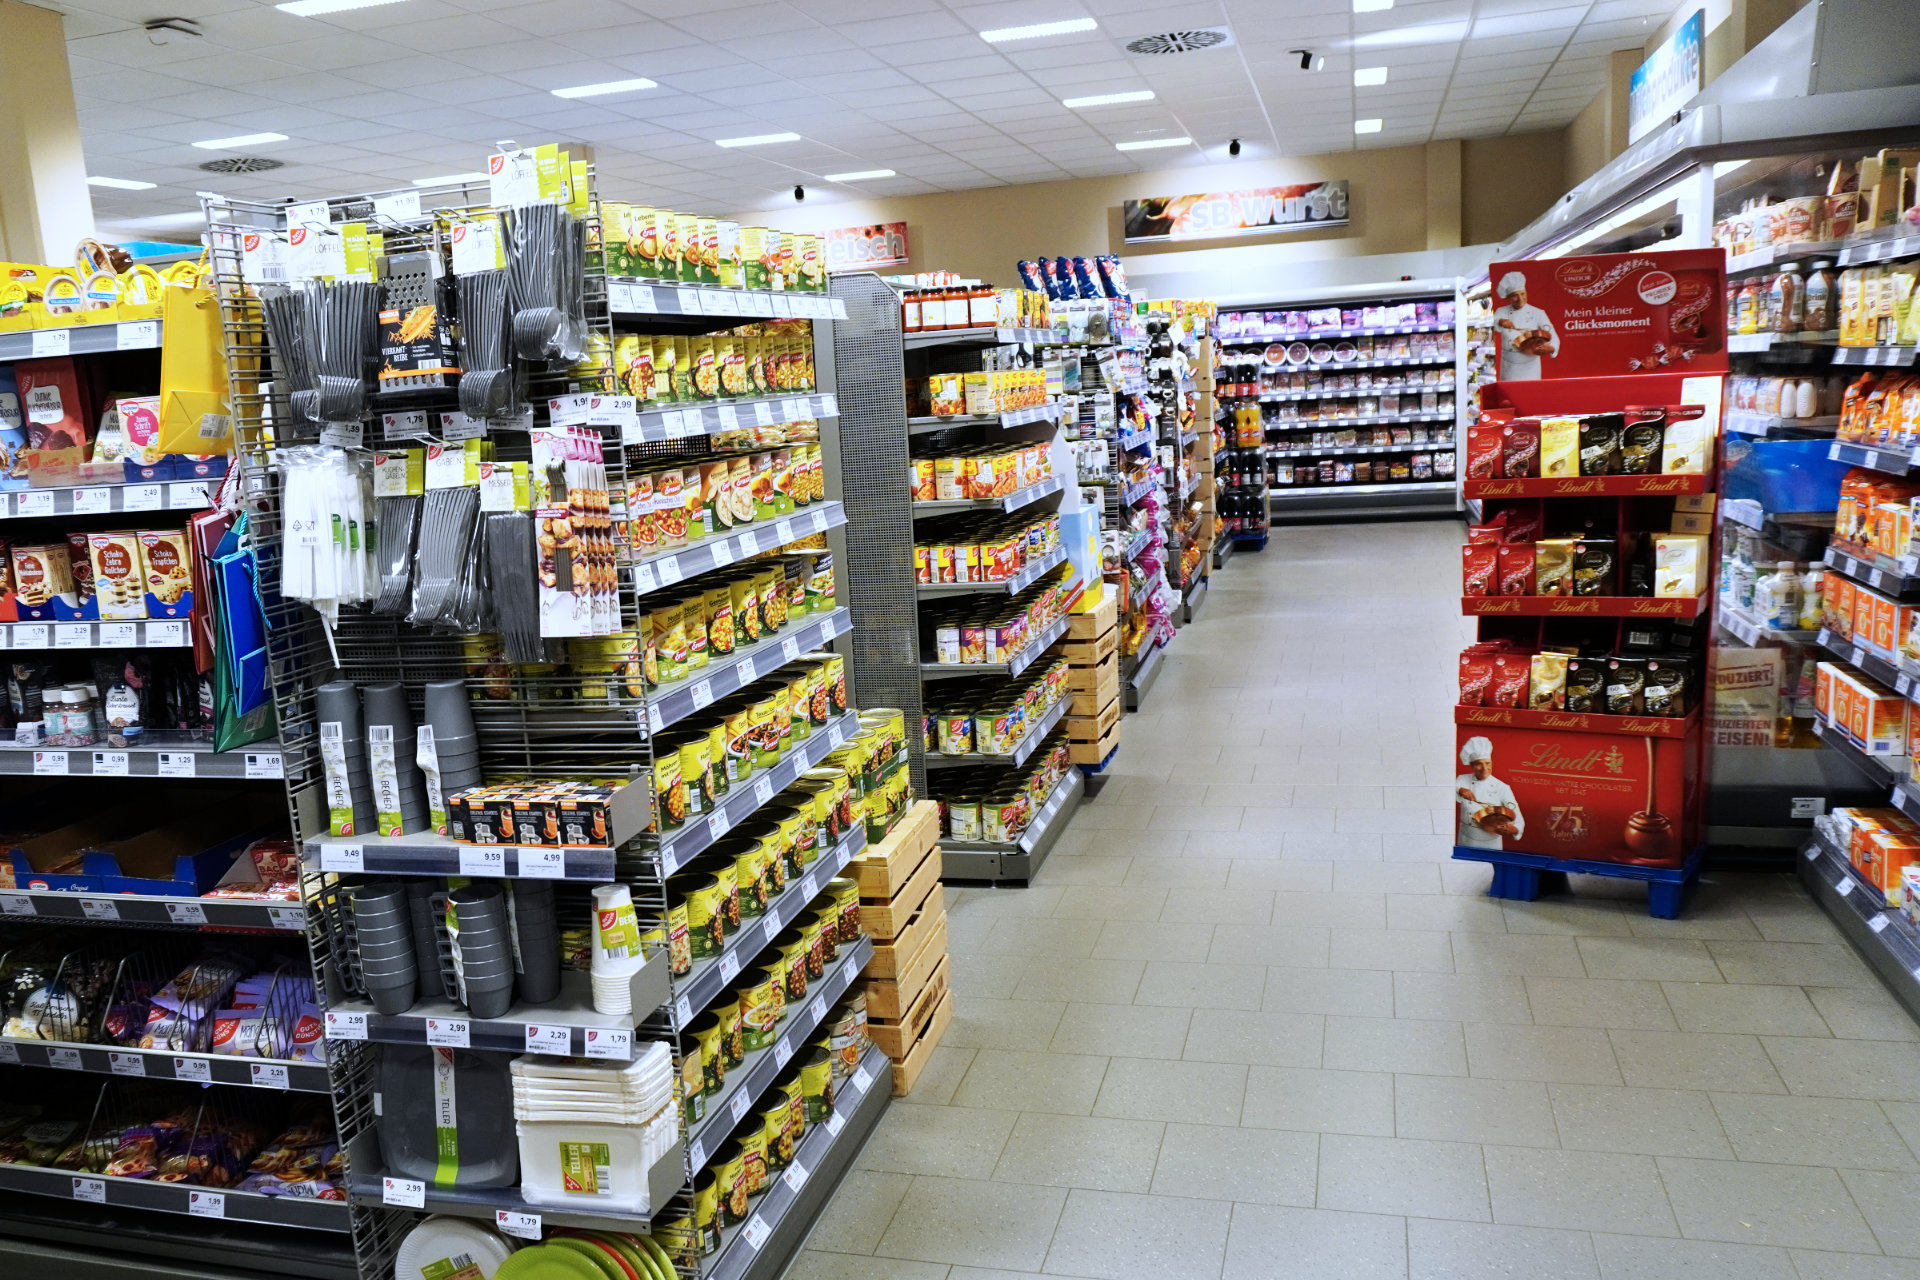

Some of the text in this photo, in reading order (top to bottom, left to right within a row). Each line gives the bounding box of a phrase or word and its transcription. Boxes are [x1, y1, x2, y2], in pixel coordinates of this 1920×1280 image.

[1190, 187, 1347, 229] SB Wurst
[830, 230, 904, 261] eisch
[1564, 305, 1634, 318] Mein kleiner
[1564, 317, 1651, 331] Glücksmoment
[614, 400, 632, 408] 2,99
[406, 415, 424, 424] 1,79
[344, 424, 360, 433] 1,39
[1478, 482, 1516, 496] Lindt
[1555, 480, 1595, 494] Lindt
[1637, 475, 1680, 491] Lindt
[1474, 599, 1514, 613] Lindt
[1550, 600, 1589, 613] Lindt
[1632, 600, 1677, 614] Lindt
[1717, 669, 1771, 685] DUZIERT
[1466, 709, 1502, 723] Lindt
[1540, 714, 1579, 728] Lindt
[1620, 719, 1661, 733] Lindt
[1717, 731, 1770, 746] EISEN!
[111, 755, 125, 763] 0,99
[265, 757, 280, 765] 1,69
[1520, 743, 1605, 772] Lindt
[332, 776, 345, 806] BECHER
[380, 780, 392, 810] BECHER
[430, 778, 439, 808] BECHER
[1550, 806, 1583, 831] 75
[344, 849, 360, 858] 9,49
[484, 853, 501, 862] 9,59
[543, 853, 561, 862] 4,99
[348, 1016, 364, 1025] 2,99
[449, 1023, 466, 1033] 2,99
[550, 1030, 567, 1040] 2,29
[610, 1034, 627, 1044] 1,79
[127, 1057, 141, 1065] 0,99
[193, 1062, 207, 1070] 0,99
[270, 1069, 284, 1077] 2,29
[441, 1097, 451, 1125] TELLER
[569, 1144, 581, 1175] TELLER
[89, 1183, 103, 1191] 0,99
[405, 1183, 422, 1193] 2,99
[519, 1217, 537, 1226] 1,79
